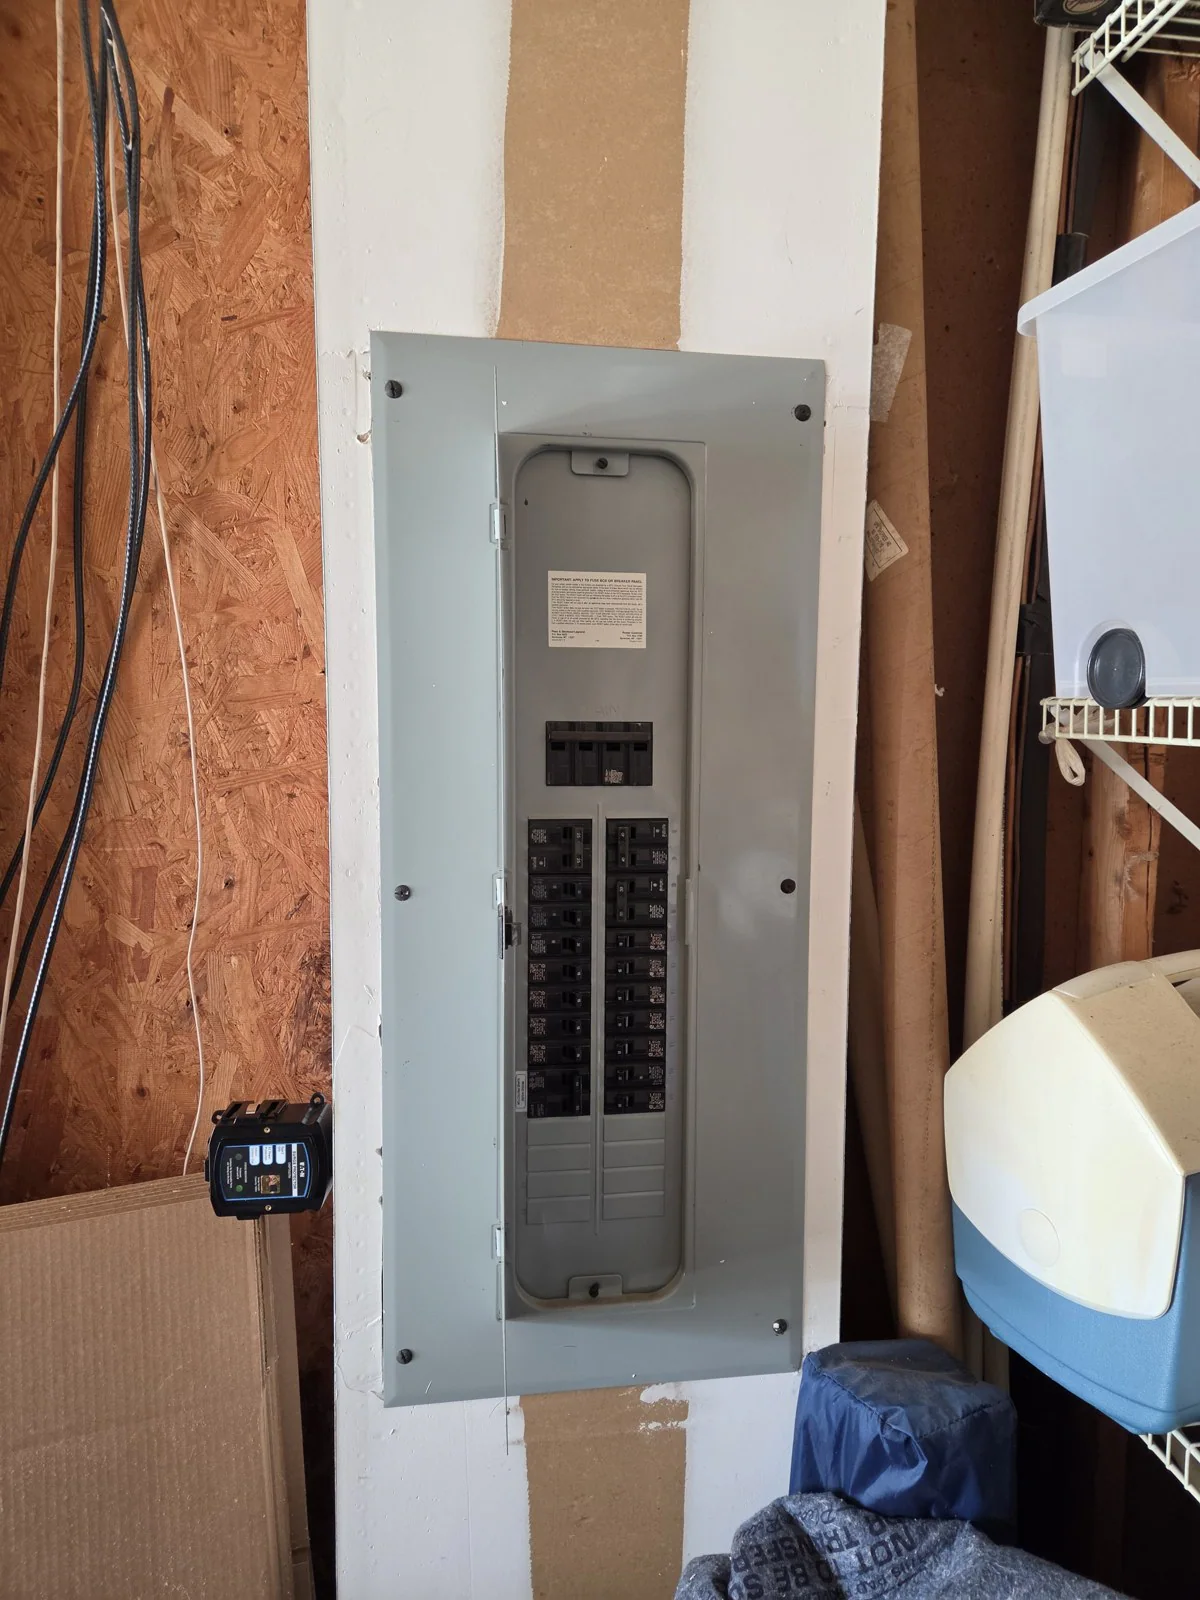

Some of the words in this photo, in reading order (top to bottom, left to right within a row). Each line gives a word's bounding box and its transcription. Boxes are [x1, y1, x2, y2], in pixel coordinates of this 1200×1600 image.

[856, 1524, 917, 1574] NOT
[774, 1563, 809, 1593] BE
[855, 1576, 888, 1595] PAD
